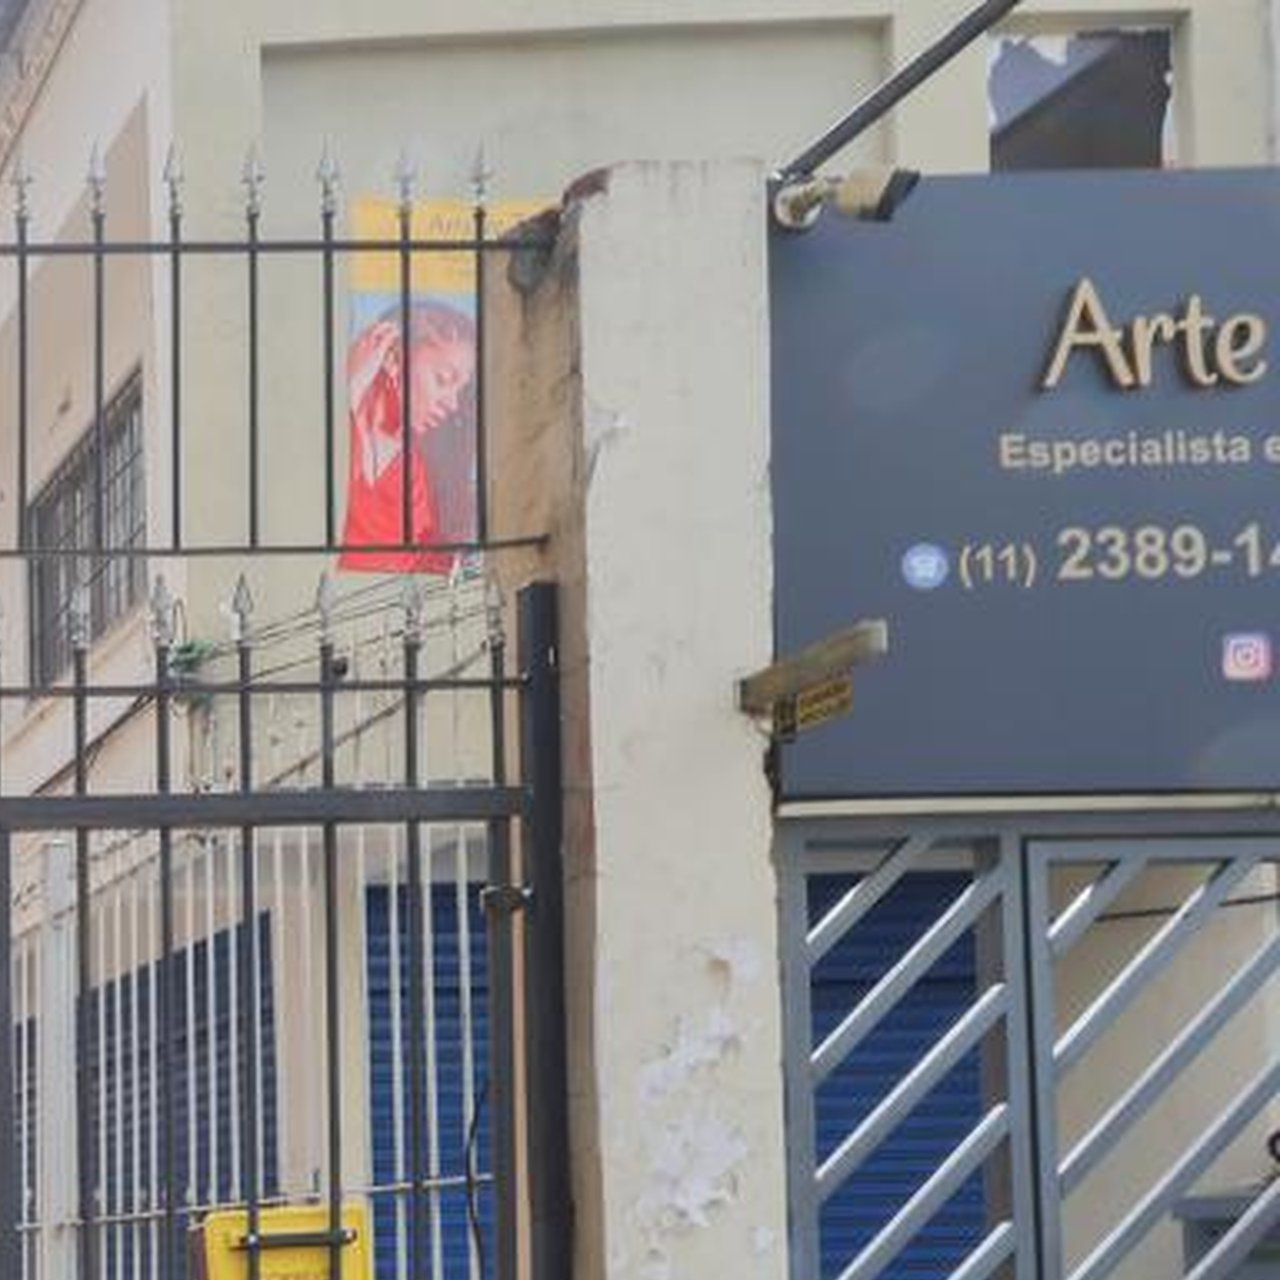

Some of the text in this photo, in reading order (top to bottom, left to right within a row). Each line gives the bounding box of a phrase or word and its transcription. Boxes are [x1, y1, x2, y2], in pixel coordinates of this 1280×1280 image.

[1043, 277, 1268, 387] Arte
[1000, 431, 1252, 474] Especialista
[960, 543, 1036, 588] (11)
